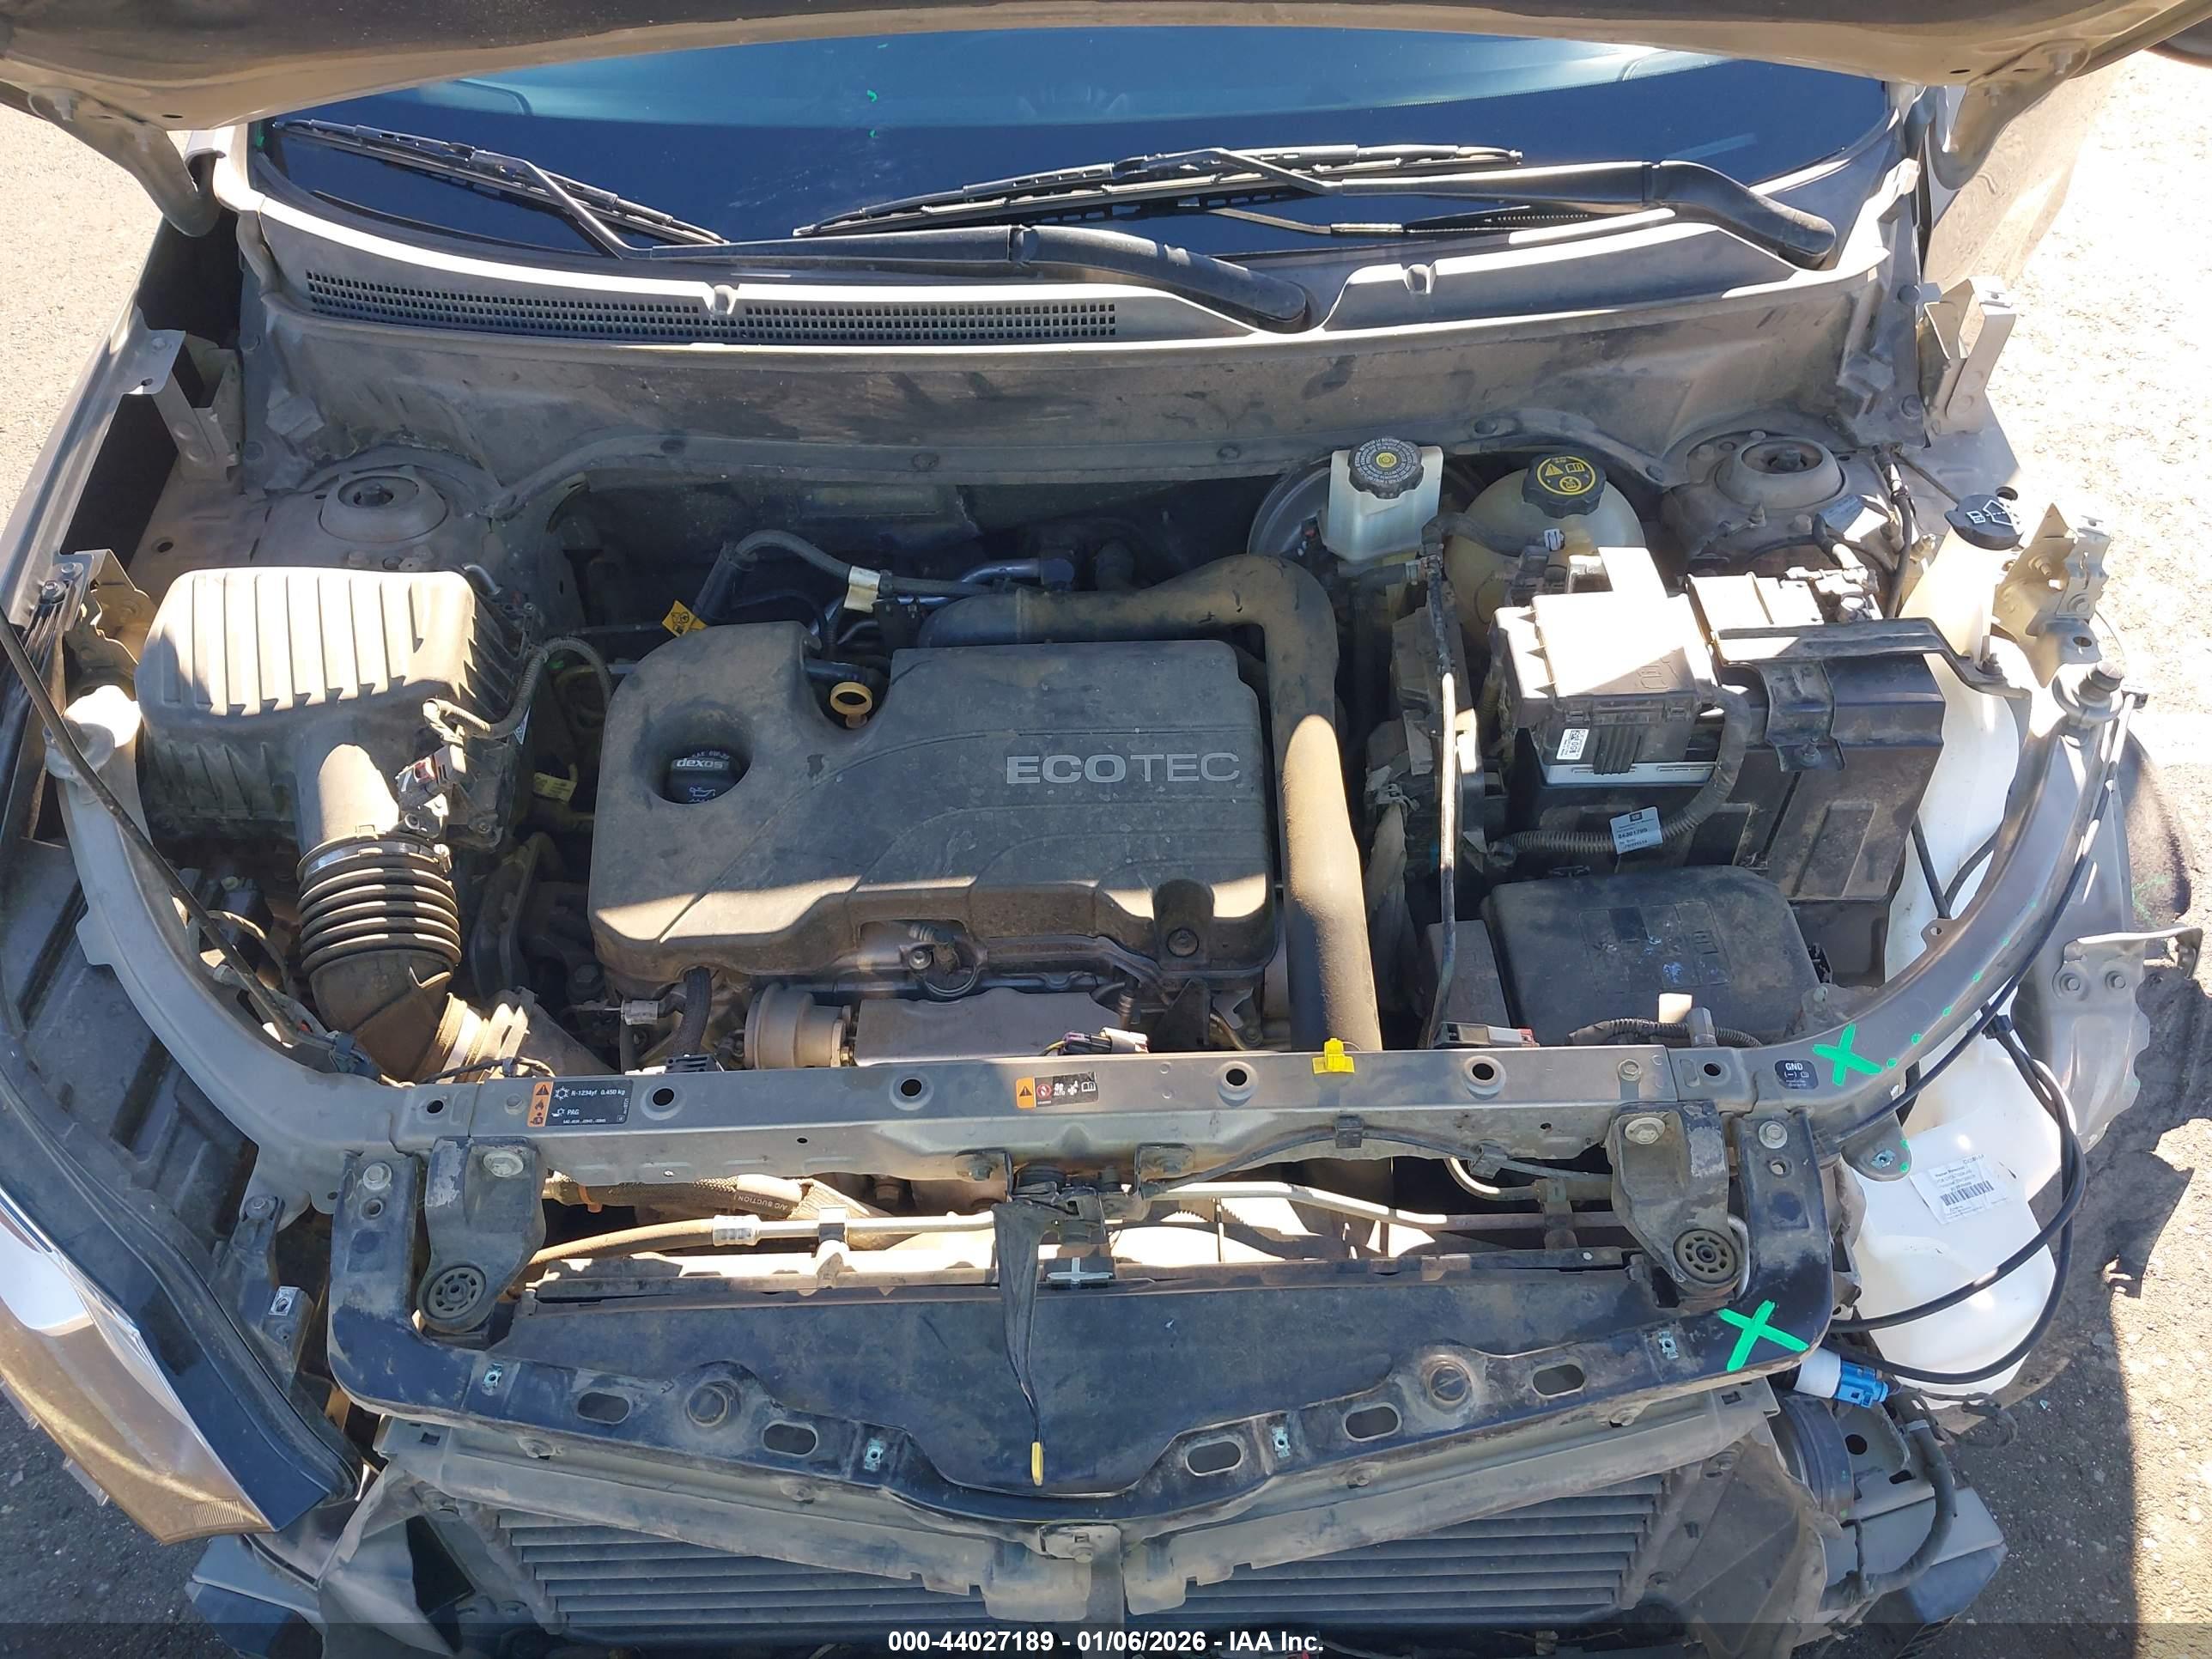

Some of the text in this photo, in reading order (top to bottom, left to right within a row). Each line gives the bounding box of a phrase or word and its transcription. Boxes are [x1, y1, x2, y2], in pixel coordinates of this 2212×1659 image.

[676, 757, 723, 769] dexos
[1006, 752, 1241, 784] ECOTEC
[1784, 1062, 1804, 1071] GND
[738, 1195, 773, 1207] SUCTION
